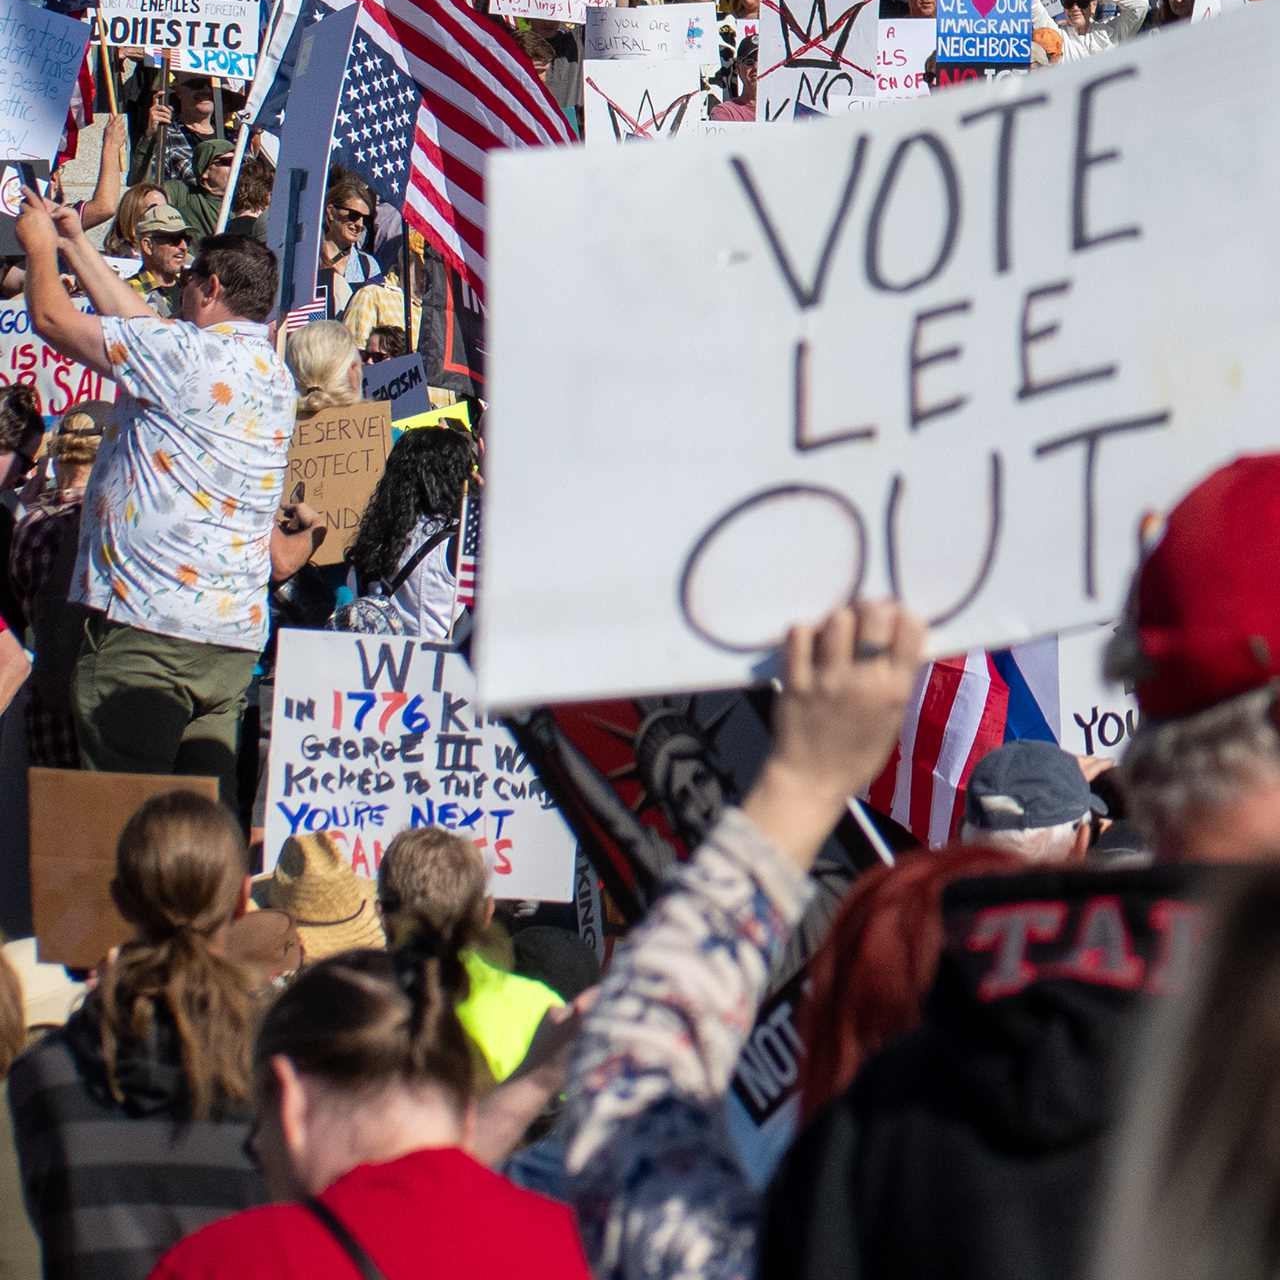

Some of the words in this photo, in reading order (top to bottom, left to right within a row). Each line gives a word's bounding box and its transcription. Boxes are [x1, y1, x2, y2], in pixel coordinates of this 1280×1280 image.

[205, 4, 247, 17] FOREIGN
[941, 19, 1030, 34] IMMIGRANT
[39, 19, 81, 63] today
[90, 16, 242, 50] DOMESTIC
[589, 38, 650, 52] NEUTRAL
[937, 37, 1030, 57] NEIGHBORS
[10, 72, 58, 99] people
[730, 68, 1143, 308] VOTE
[794, 280, 1116, 452] LEE
[679, 409, 1170, 651] OUT
[333, 691, 431, 734] 1776
[411, 797, 514, 839] NEXT
